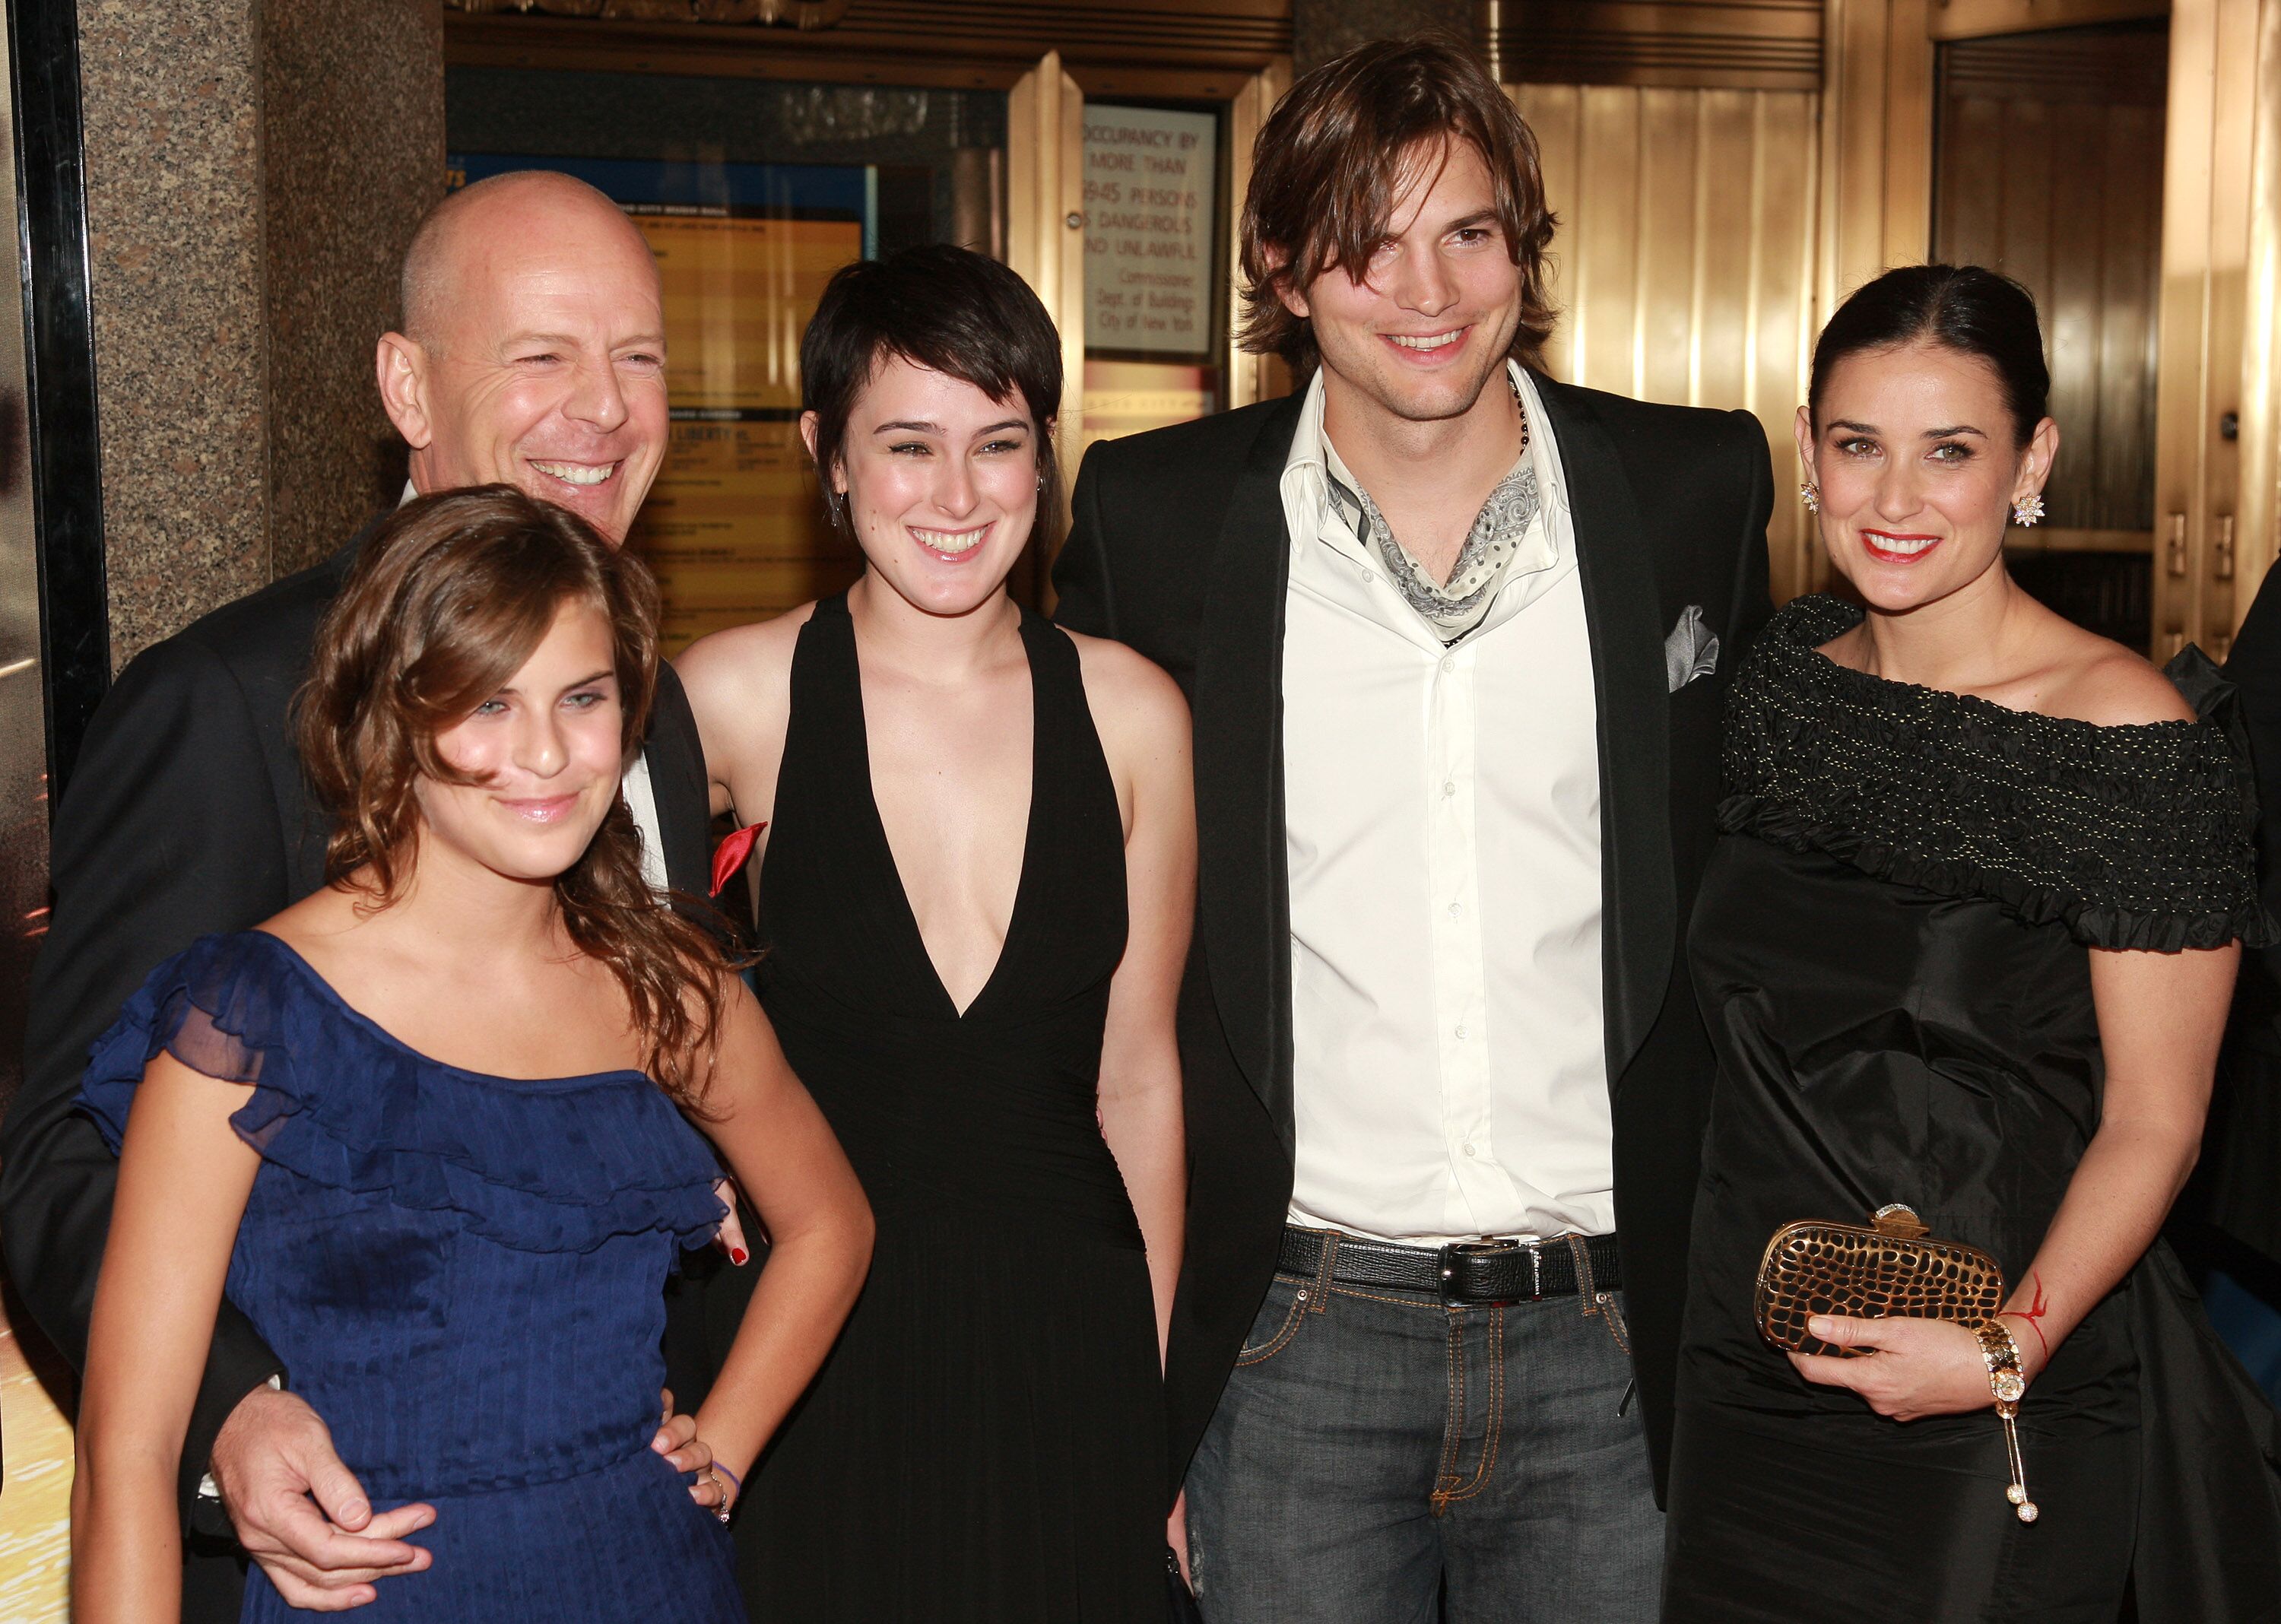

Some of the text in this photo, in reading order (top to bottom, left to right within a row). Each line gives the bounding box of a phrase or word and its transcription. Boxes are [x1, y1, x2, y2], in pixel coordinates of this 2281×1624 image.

[1179, 131, 1199, 150] BY
[1090, 153, 1186, 175] MORE THAN
